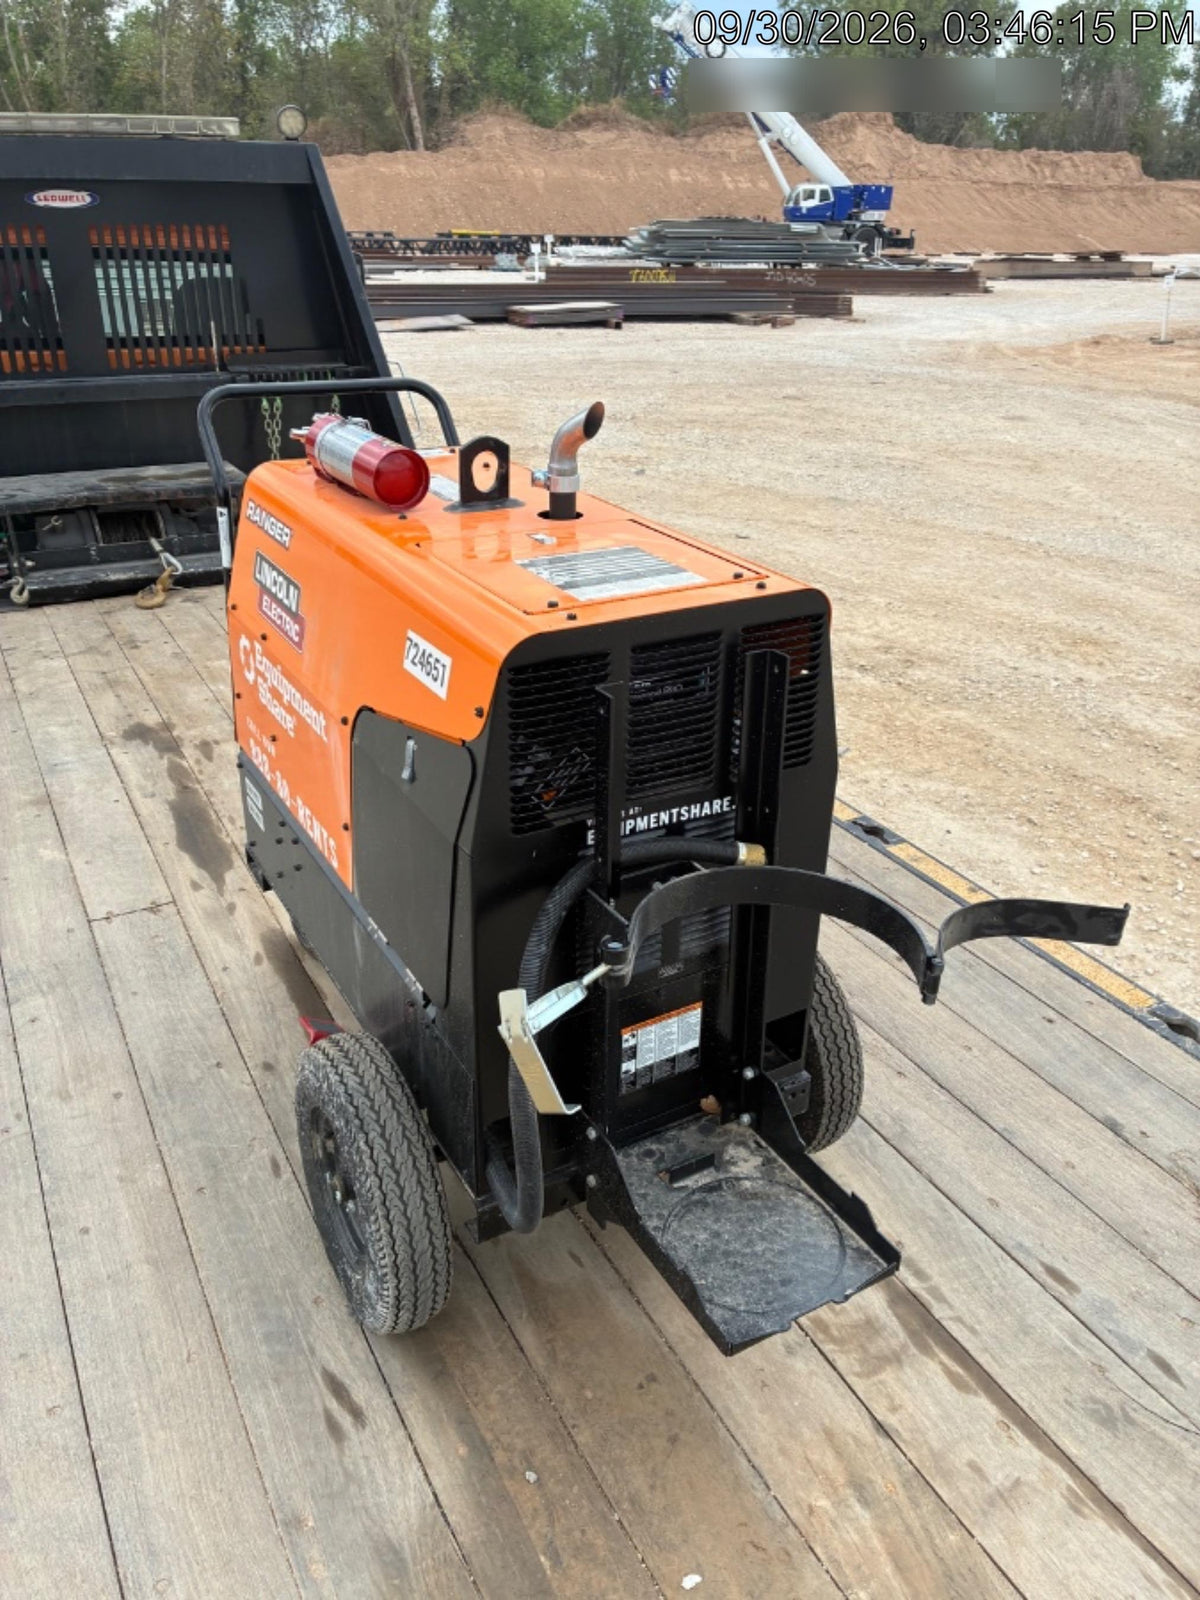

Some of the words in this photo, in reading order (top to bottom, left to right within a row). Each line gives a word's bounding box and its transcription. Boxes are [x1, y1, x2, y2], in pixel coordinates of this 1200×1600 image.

[246, 500, 291, 549] RANGER
[255, 555, 300, 614] LINCOLN
[262, 594, 300, 643] ELECTRIC
[405, 636, 447, 688] 724651
[254, 640, 328, 743] Equipment
[257, 674, 296, 738] Share
